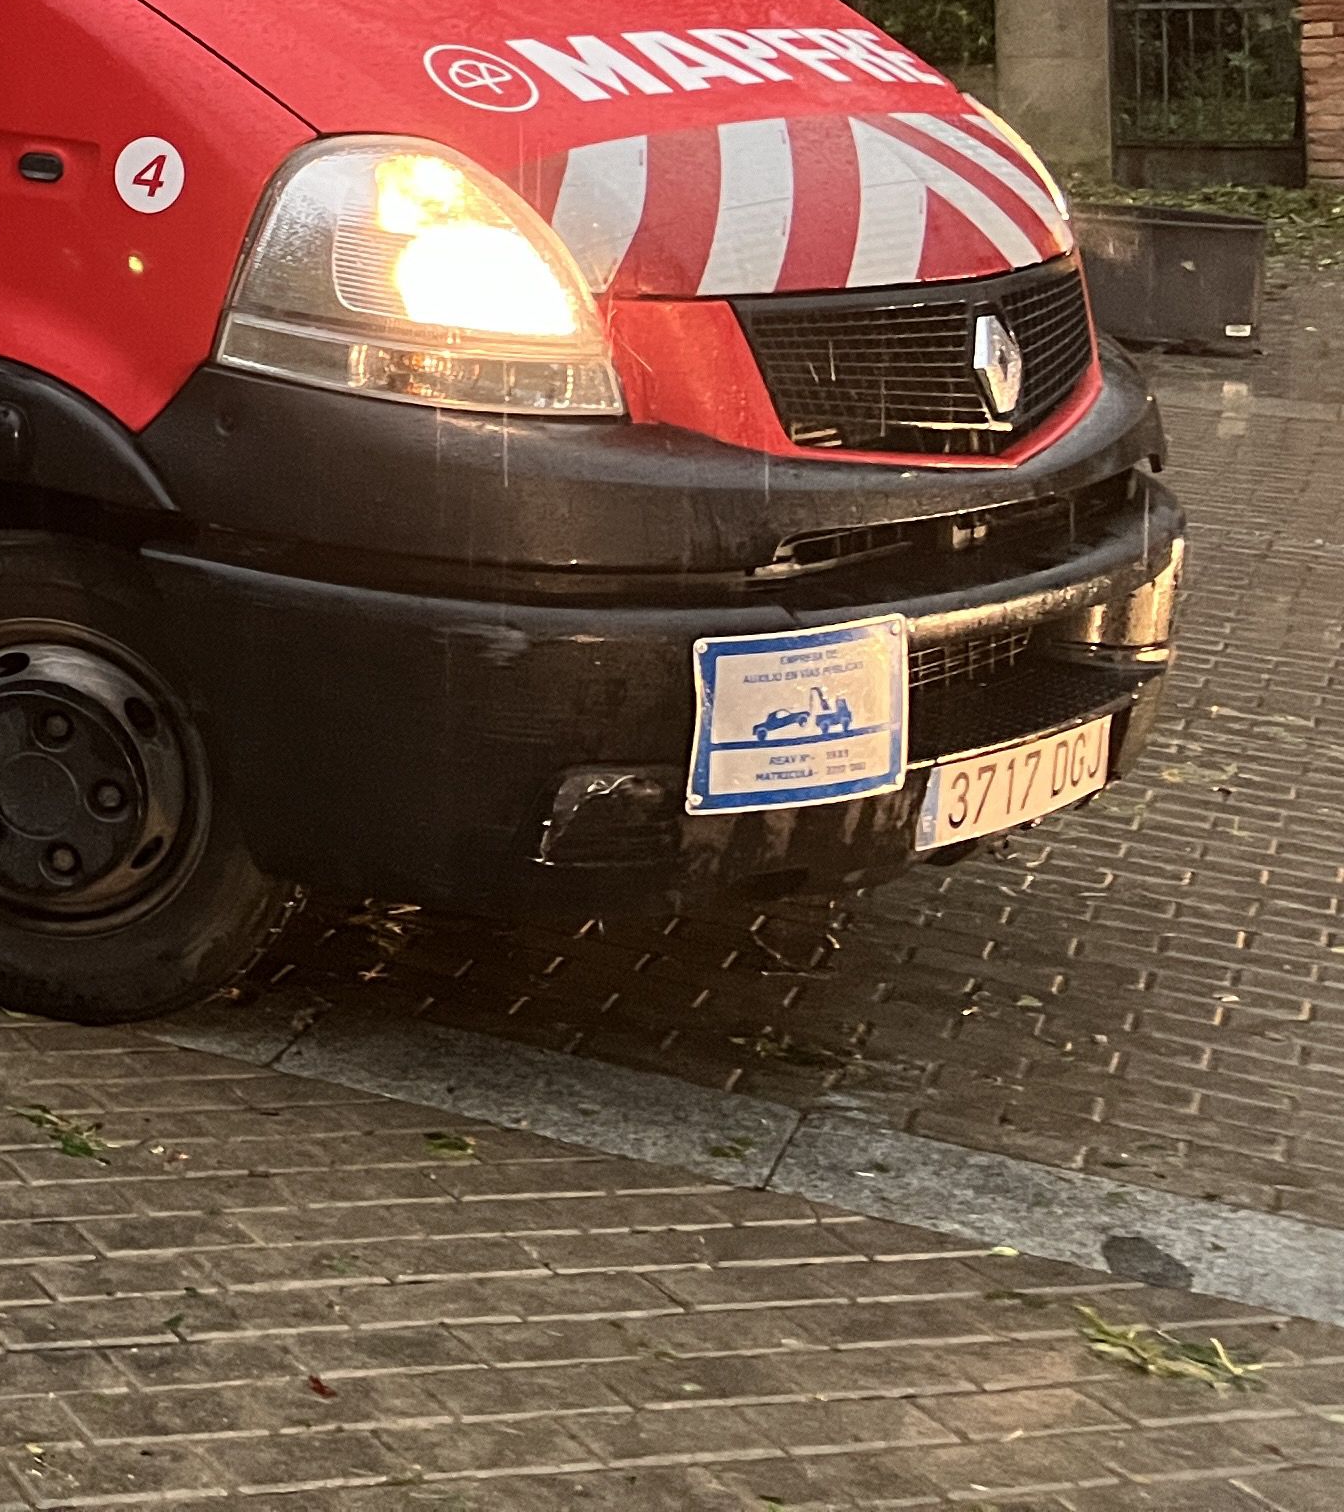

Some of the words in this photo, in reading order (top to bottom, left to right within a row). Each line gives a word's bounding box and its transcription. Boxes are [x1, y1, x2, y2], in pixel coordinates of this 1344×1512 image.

[505, 28, 946, 102] MAPFRE
[132, 154, 167, 197] 4
[948, 749, 1042, 830] 3717
[1050, 722, 1105, 799] DGJ
